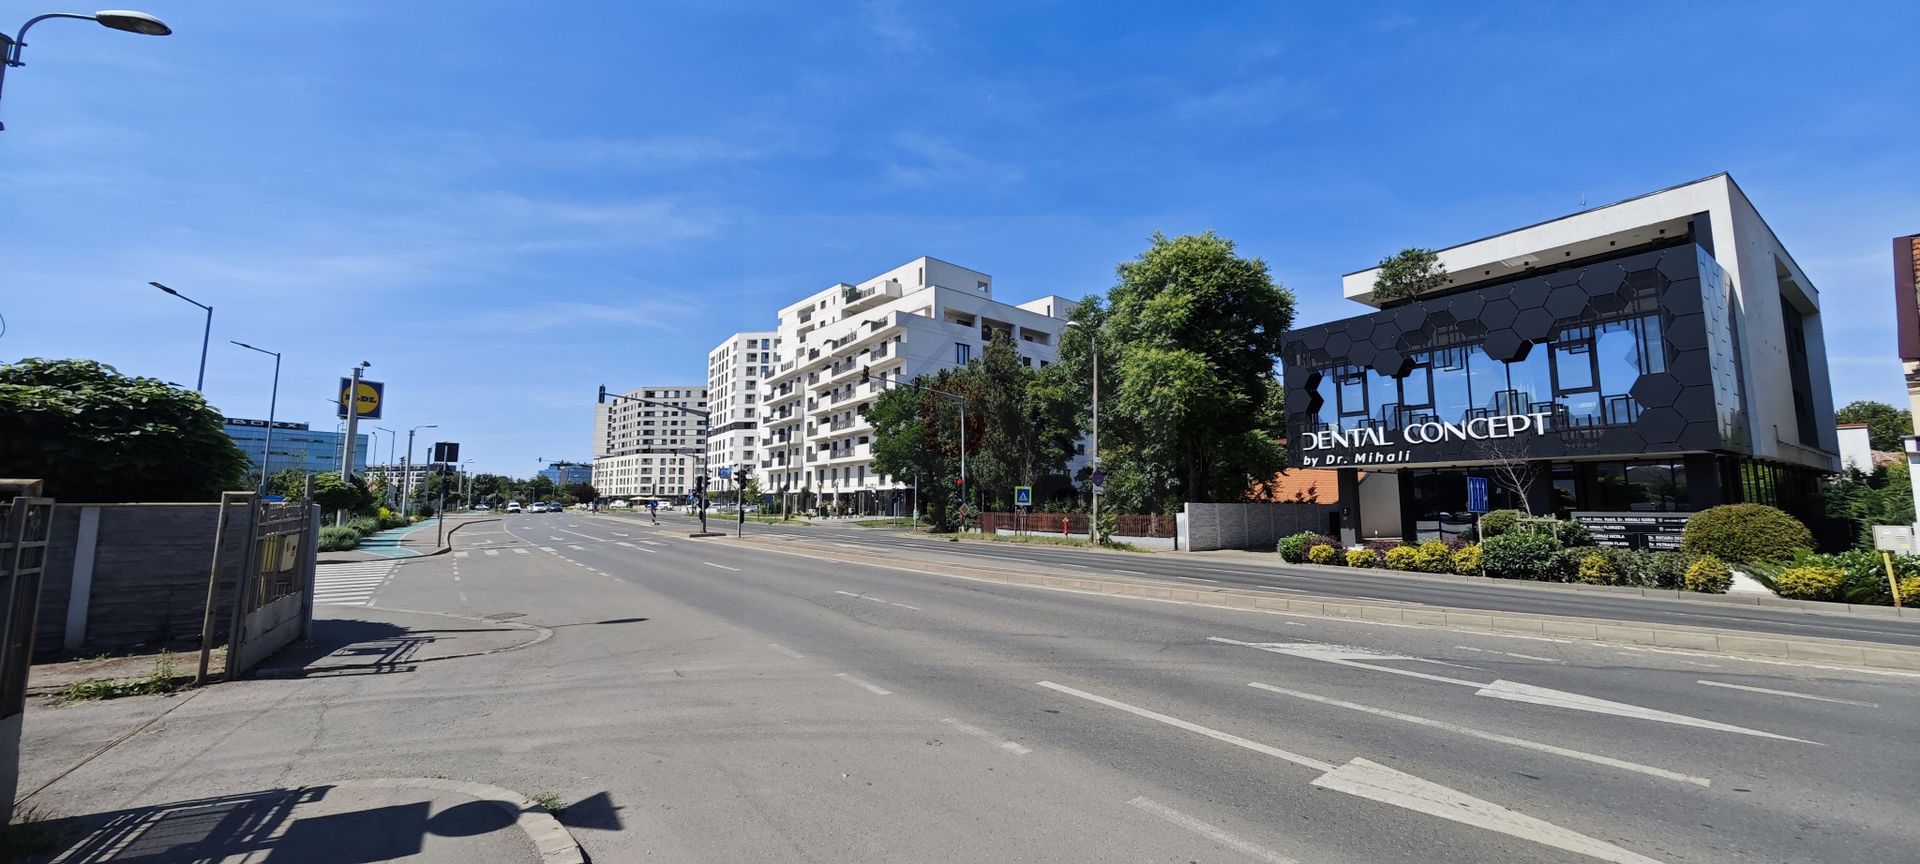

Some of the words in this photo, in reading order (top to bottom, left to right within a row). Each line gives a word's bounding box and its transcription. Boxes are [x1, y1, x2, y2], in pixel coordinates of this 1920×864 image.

[1302, 426, 1395, 450] DENTAL
[1403, 411, 1552, 444] CONCEPT
[1303, 456, 1319, 467] by
[1326, 454, 1348, 465] Dr.
[1354, 450, 1411, 464] Mihali
